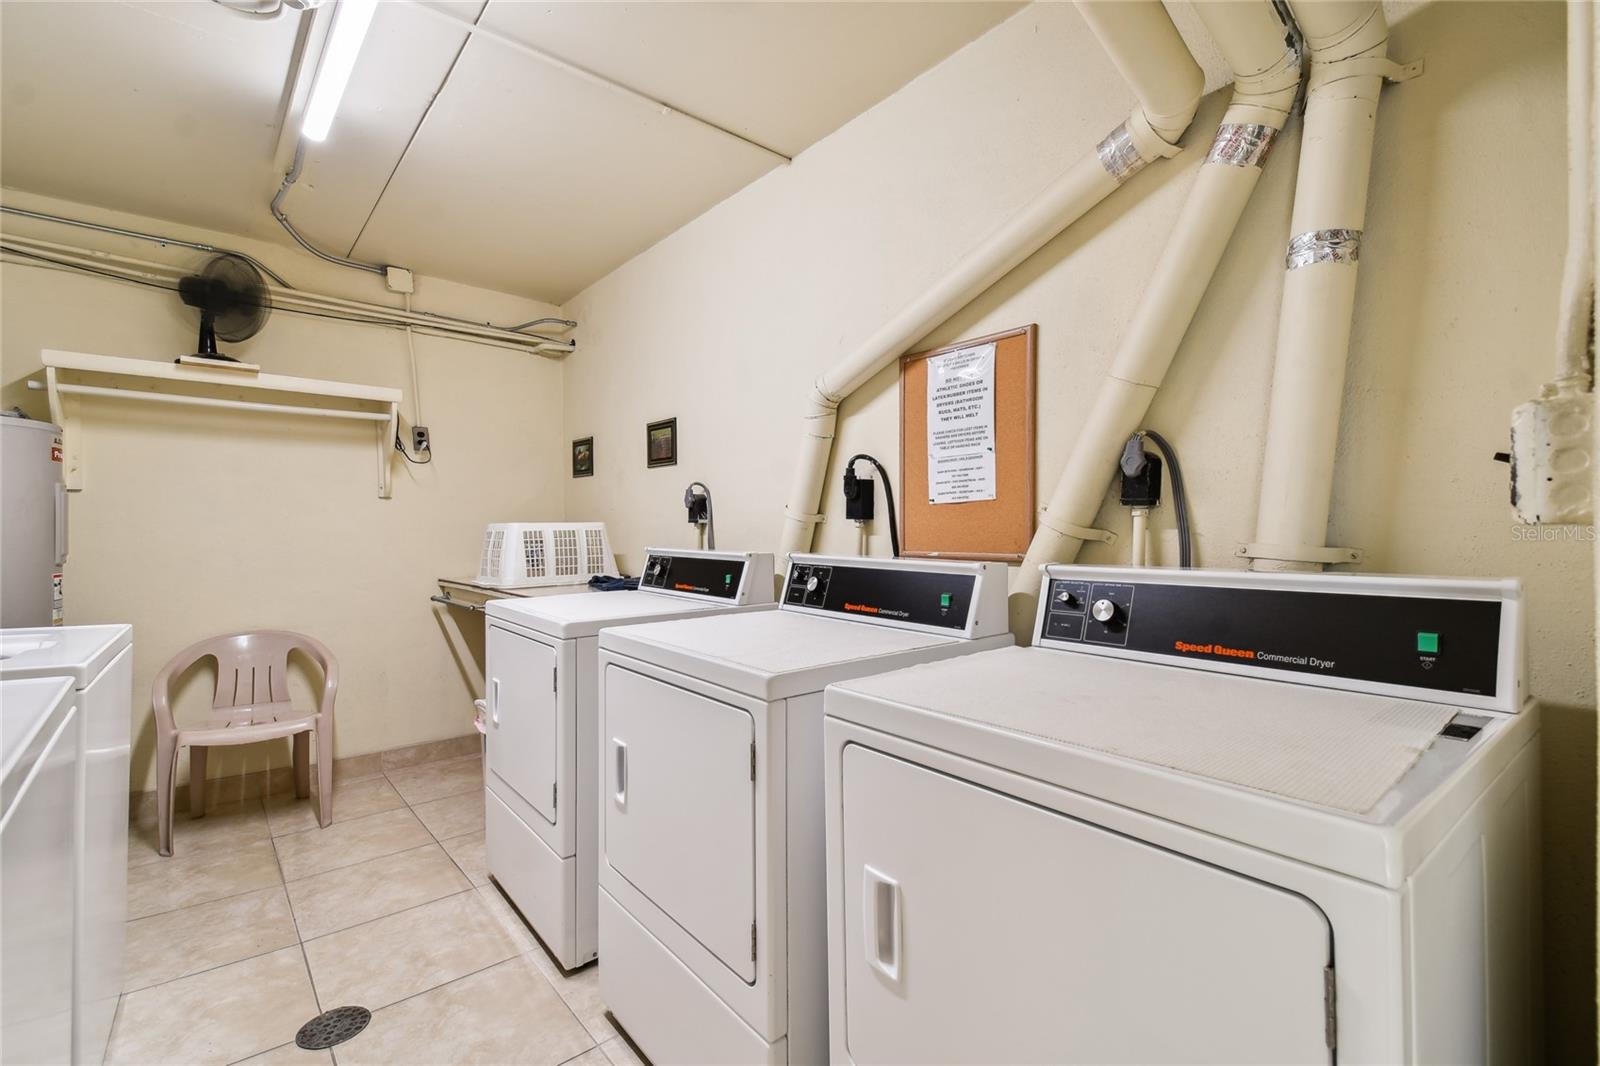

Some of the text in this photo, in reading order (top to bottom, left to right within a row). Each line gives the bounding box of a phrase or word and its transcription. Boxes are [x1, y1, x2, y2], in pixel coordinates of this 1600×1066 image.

[936, 384, 958, 393] ATHLETIC
[1175, 641, 1335, 669] Speed Queen Commercial Dryer
